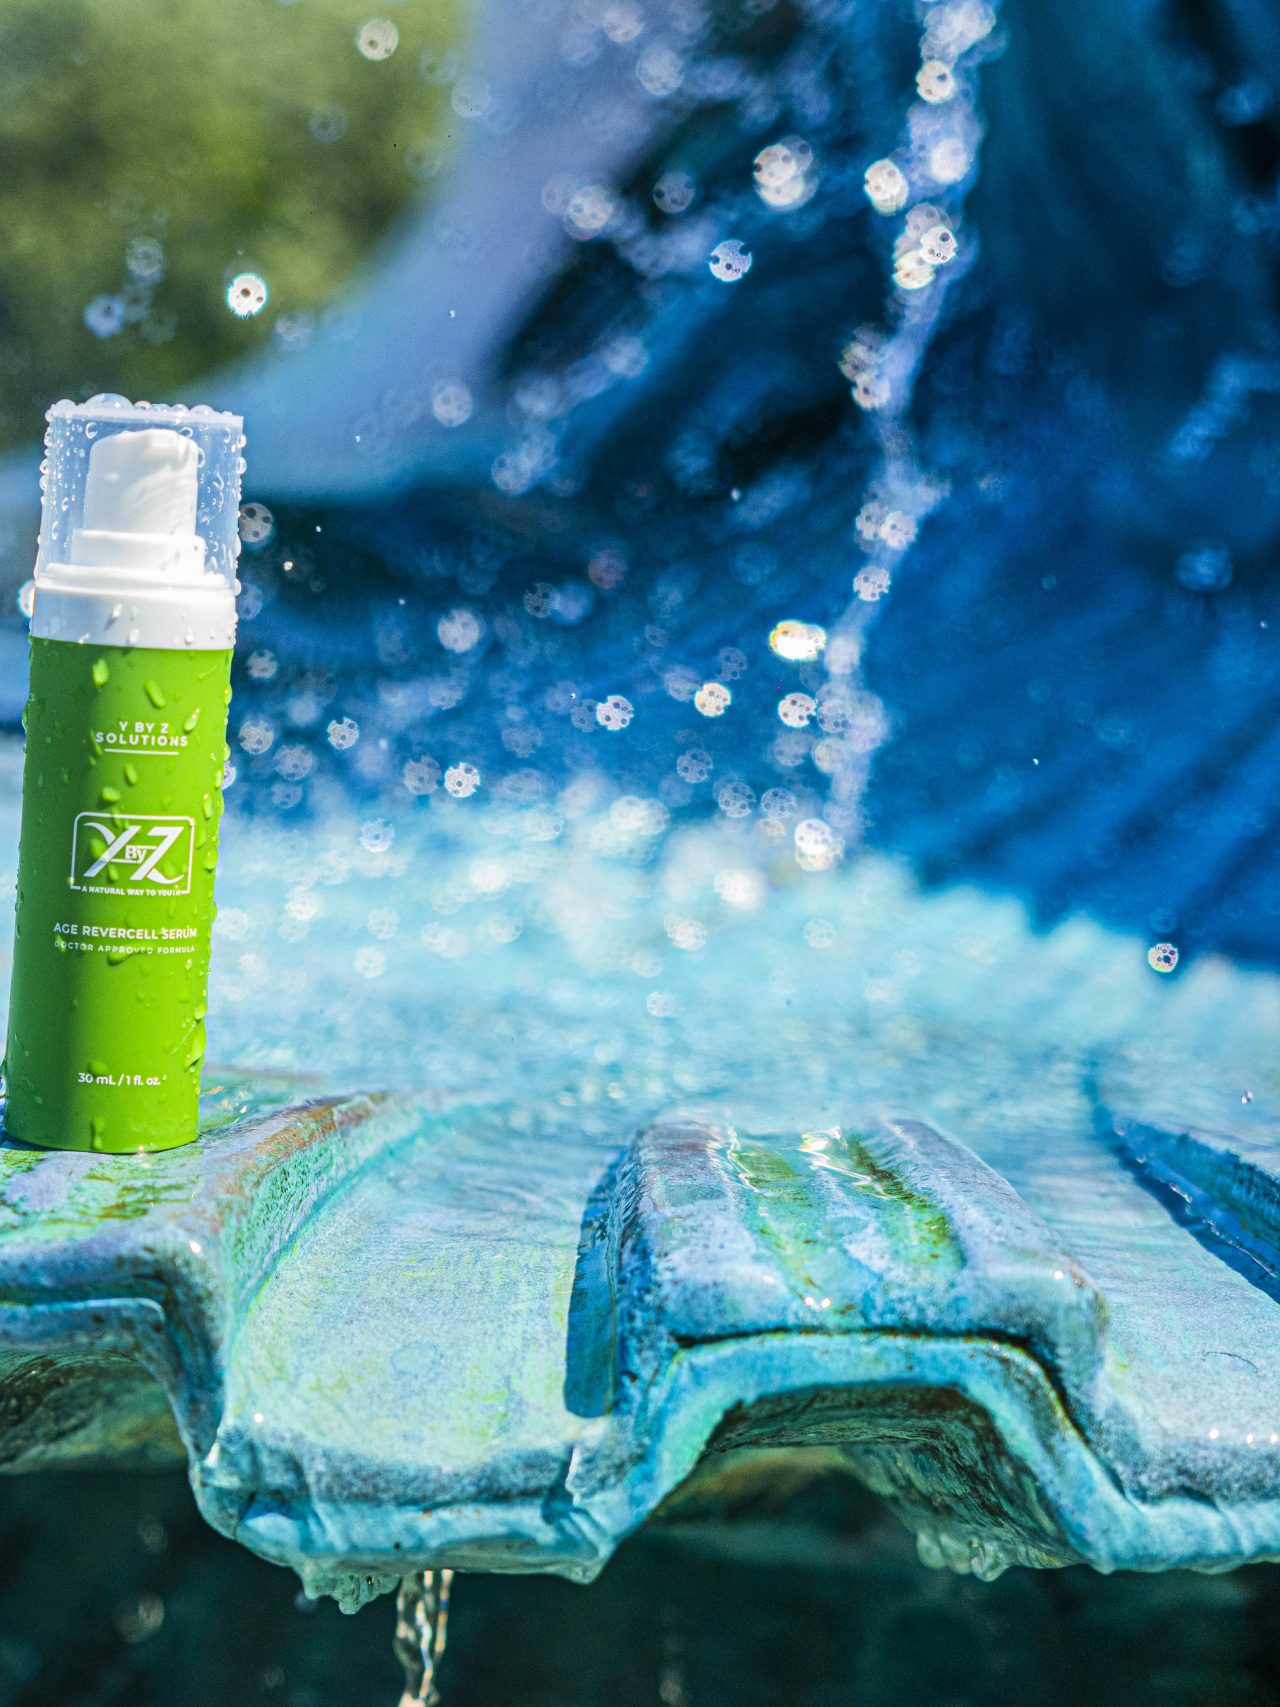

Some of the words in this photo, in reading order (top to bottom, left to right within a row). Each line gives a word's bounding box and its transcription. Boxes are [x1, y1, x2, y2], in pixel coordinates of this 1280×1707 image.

[119, 721, 128, 732] Y
[135, 722, 154, 733] BY
[161, 723, 169, 734] Z
[96, 732, 188, 747] SOLUTIONS
[89, 886, 125, 895] NATURAL
[127, 888, 144, 896] WAY
[54, 923, 78, 935] AGE
[83, 926, 158, 939] REVERCELL
[162, 928, 197, 939] SERUM
[54, 940, 94, 952] DOCTOR
[98, 945, 153, 954] APPROVED
[157, 946, 195, 954] FORMULA
[78, 1072, 93, 1083] 30
[96, 1075, 116, 1085] mL
[117, 1073, 124, 1086] /
[125, 1075, 130, 1085] 1
[133, 1075, 144, 1085] fl.
[146, 1077, 160, 1086] oz.
